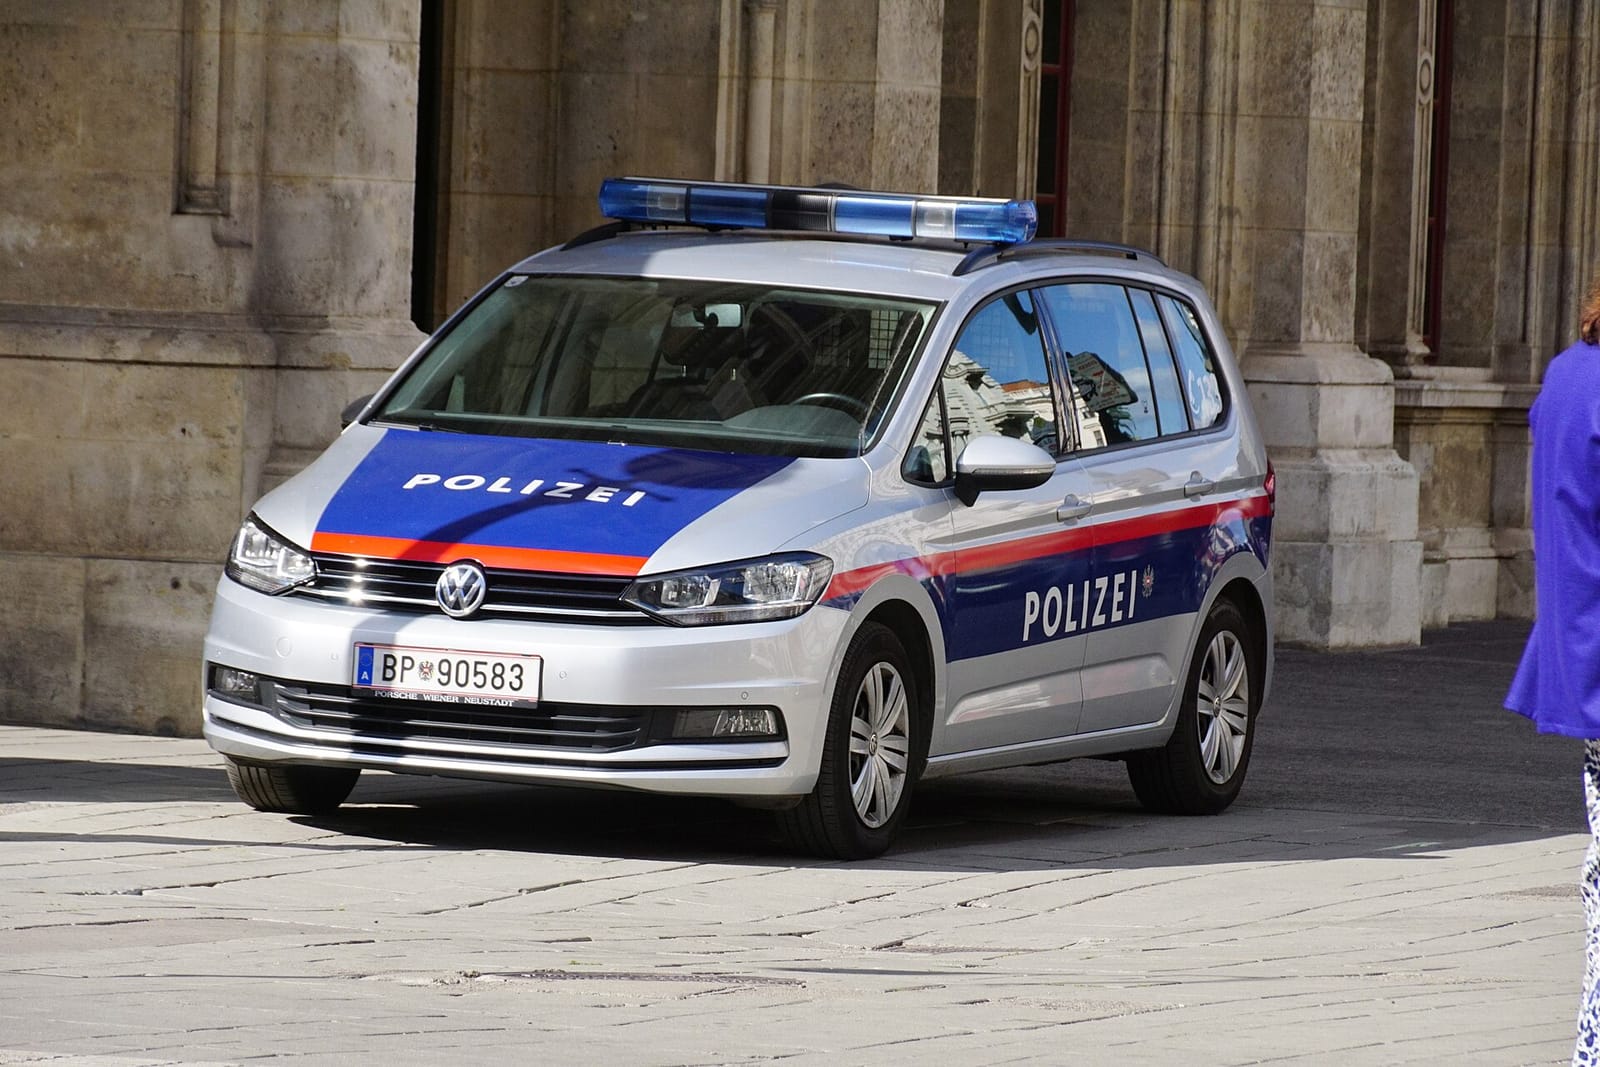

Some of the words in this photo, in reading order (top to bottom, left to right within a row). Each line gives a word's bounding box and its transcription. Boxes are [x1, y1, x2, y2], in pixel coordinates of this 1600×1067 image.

[402, 473, 647, 507] POLIZEI
[436, 564, 486, 617] VW
[1022, 569, 1137, 642] POLIZEI
[361, 671, 369, 680] A
[382, 654, 415, 682] BP
[437, 659, 524, 691] 90583
[374, 690, 418, 700] PORSCHE
[423, 693, 459, 703] WIENER
[464, 697, 514, 707] NEUSTADT
